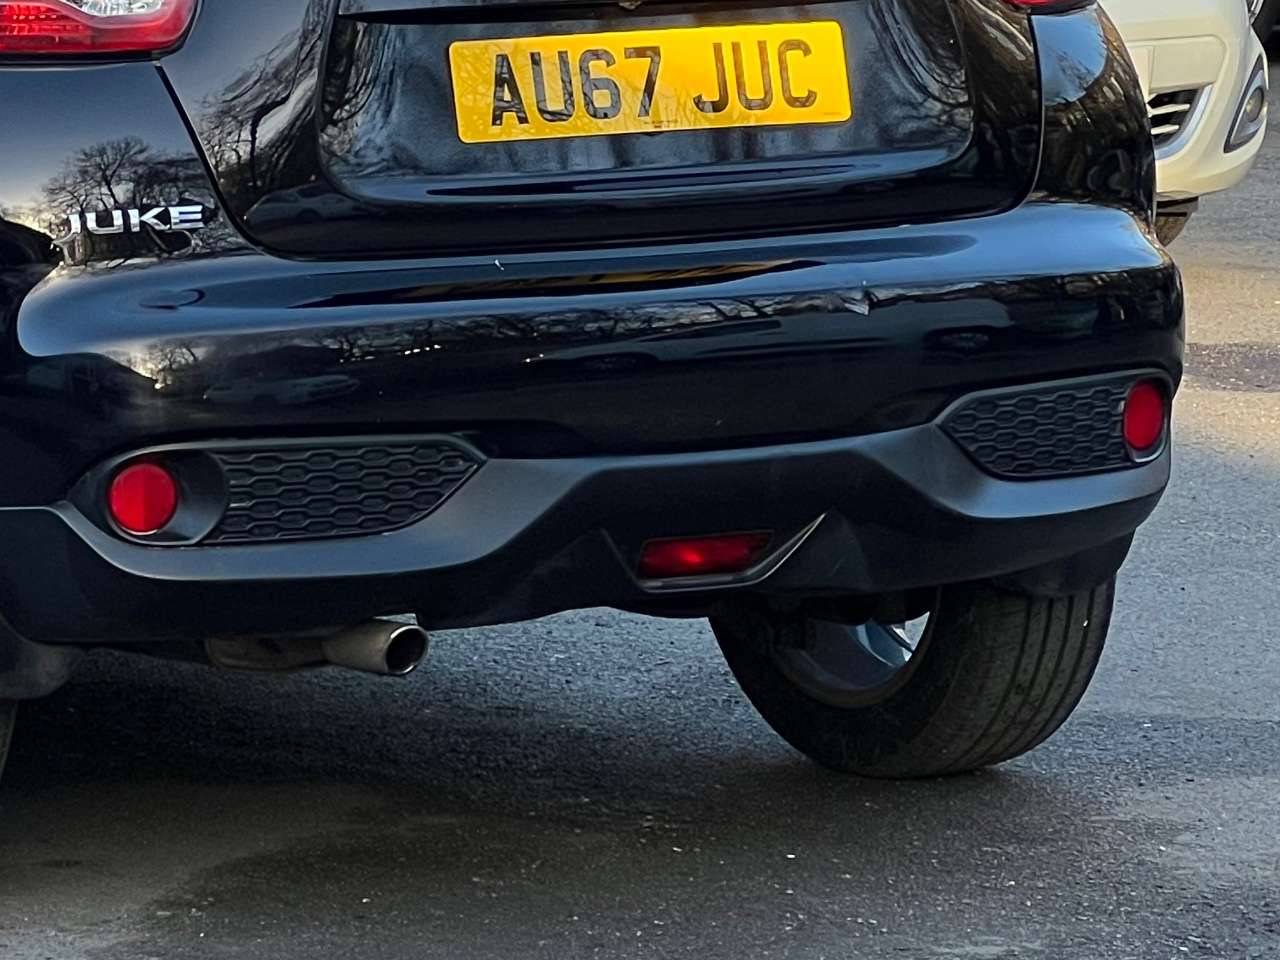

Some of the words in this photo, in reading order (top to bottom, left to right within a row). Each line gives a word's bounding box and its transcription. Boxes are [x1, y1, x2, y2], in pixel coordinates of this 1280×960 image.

[492, 46, 661, 126] AU67
[693, 40, 817, 114] JUC
[63, 205, 205, 237] JUKE
